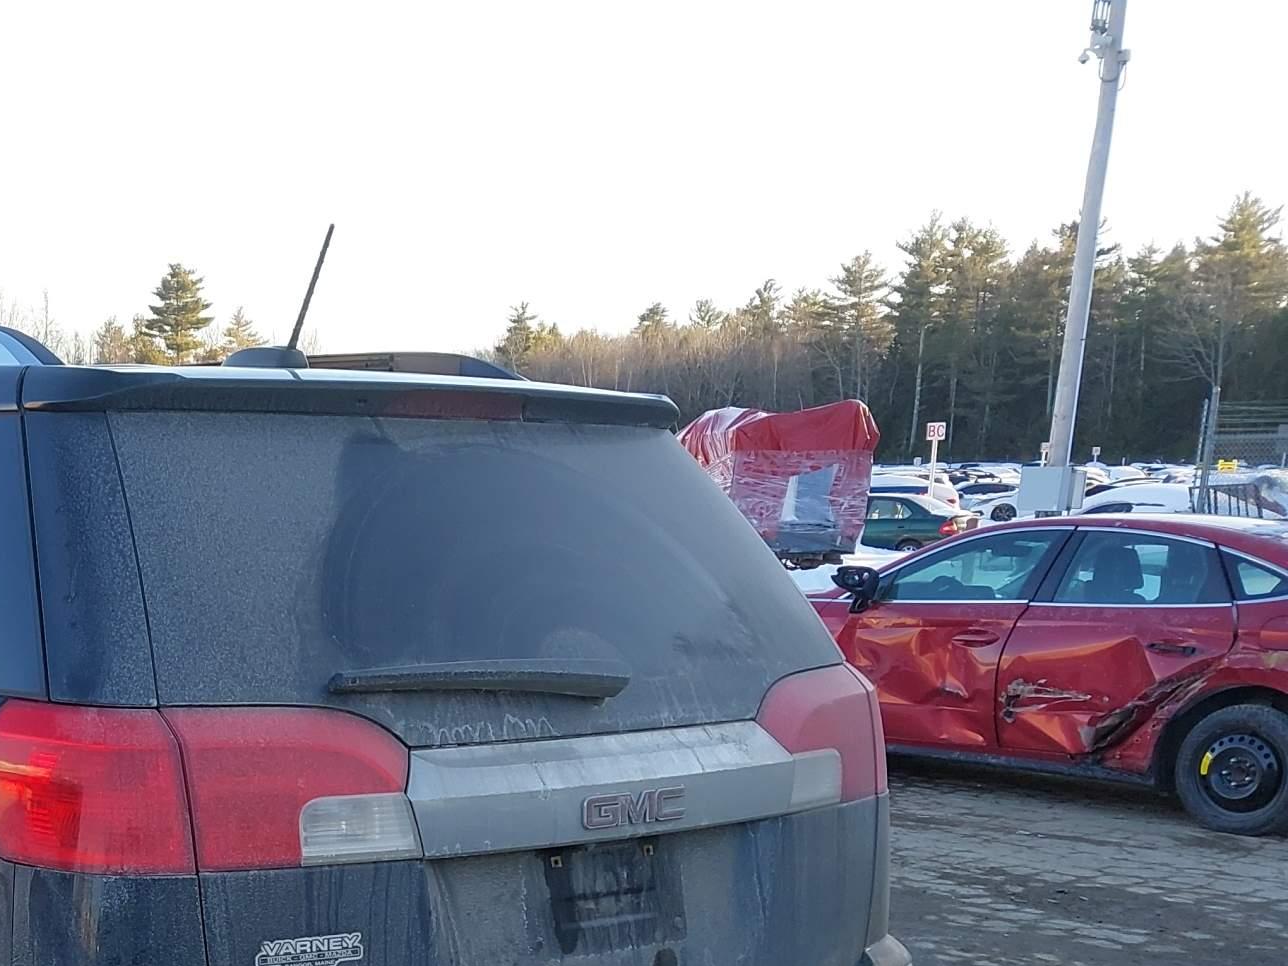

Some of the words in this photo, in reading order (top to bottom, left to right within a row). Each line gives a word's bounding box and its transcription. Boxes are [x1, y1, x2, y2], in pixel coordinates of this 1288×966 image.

[928, 425, 944, 437] BC
[584, 784, 686, 829] GMC
[262, 935, 358, 956] VARNEY
